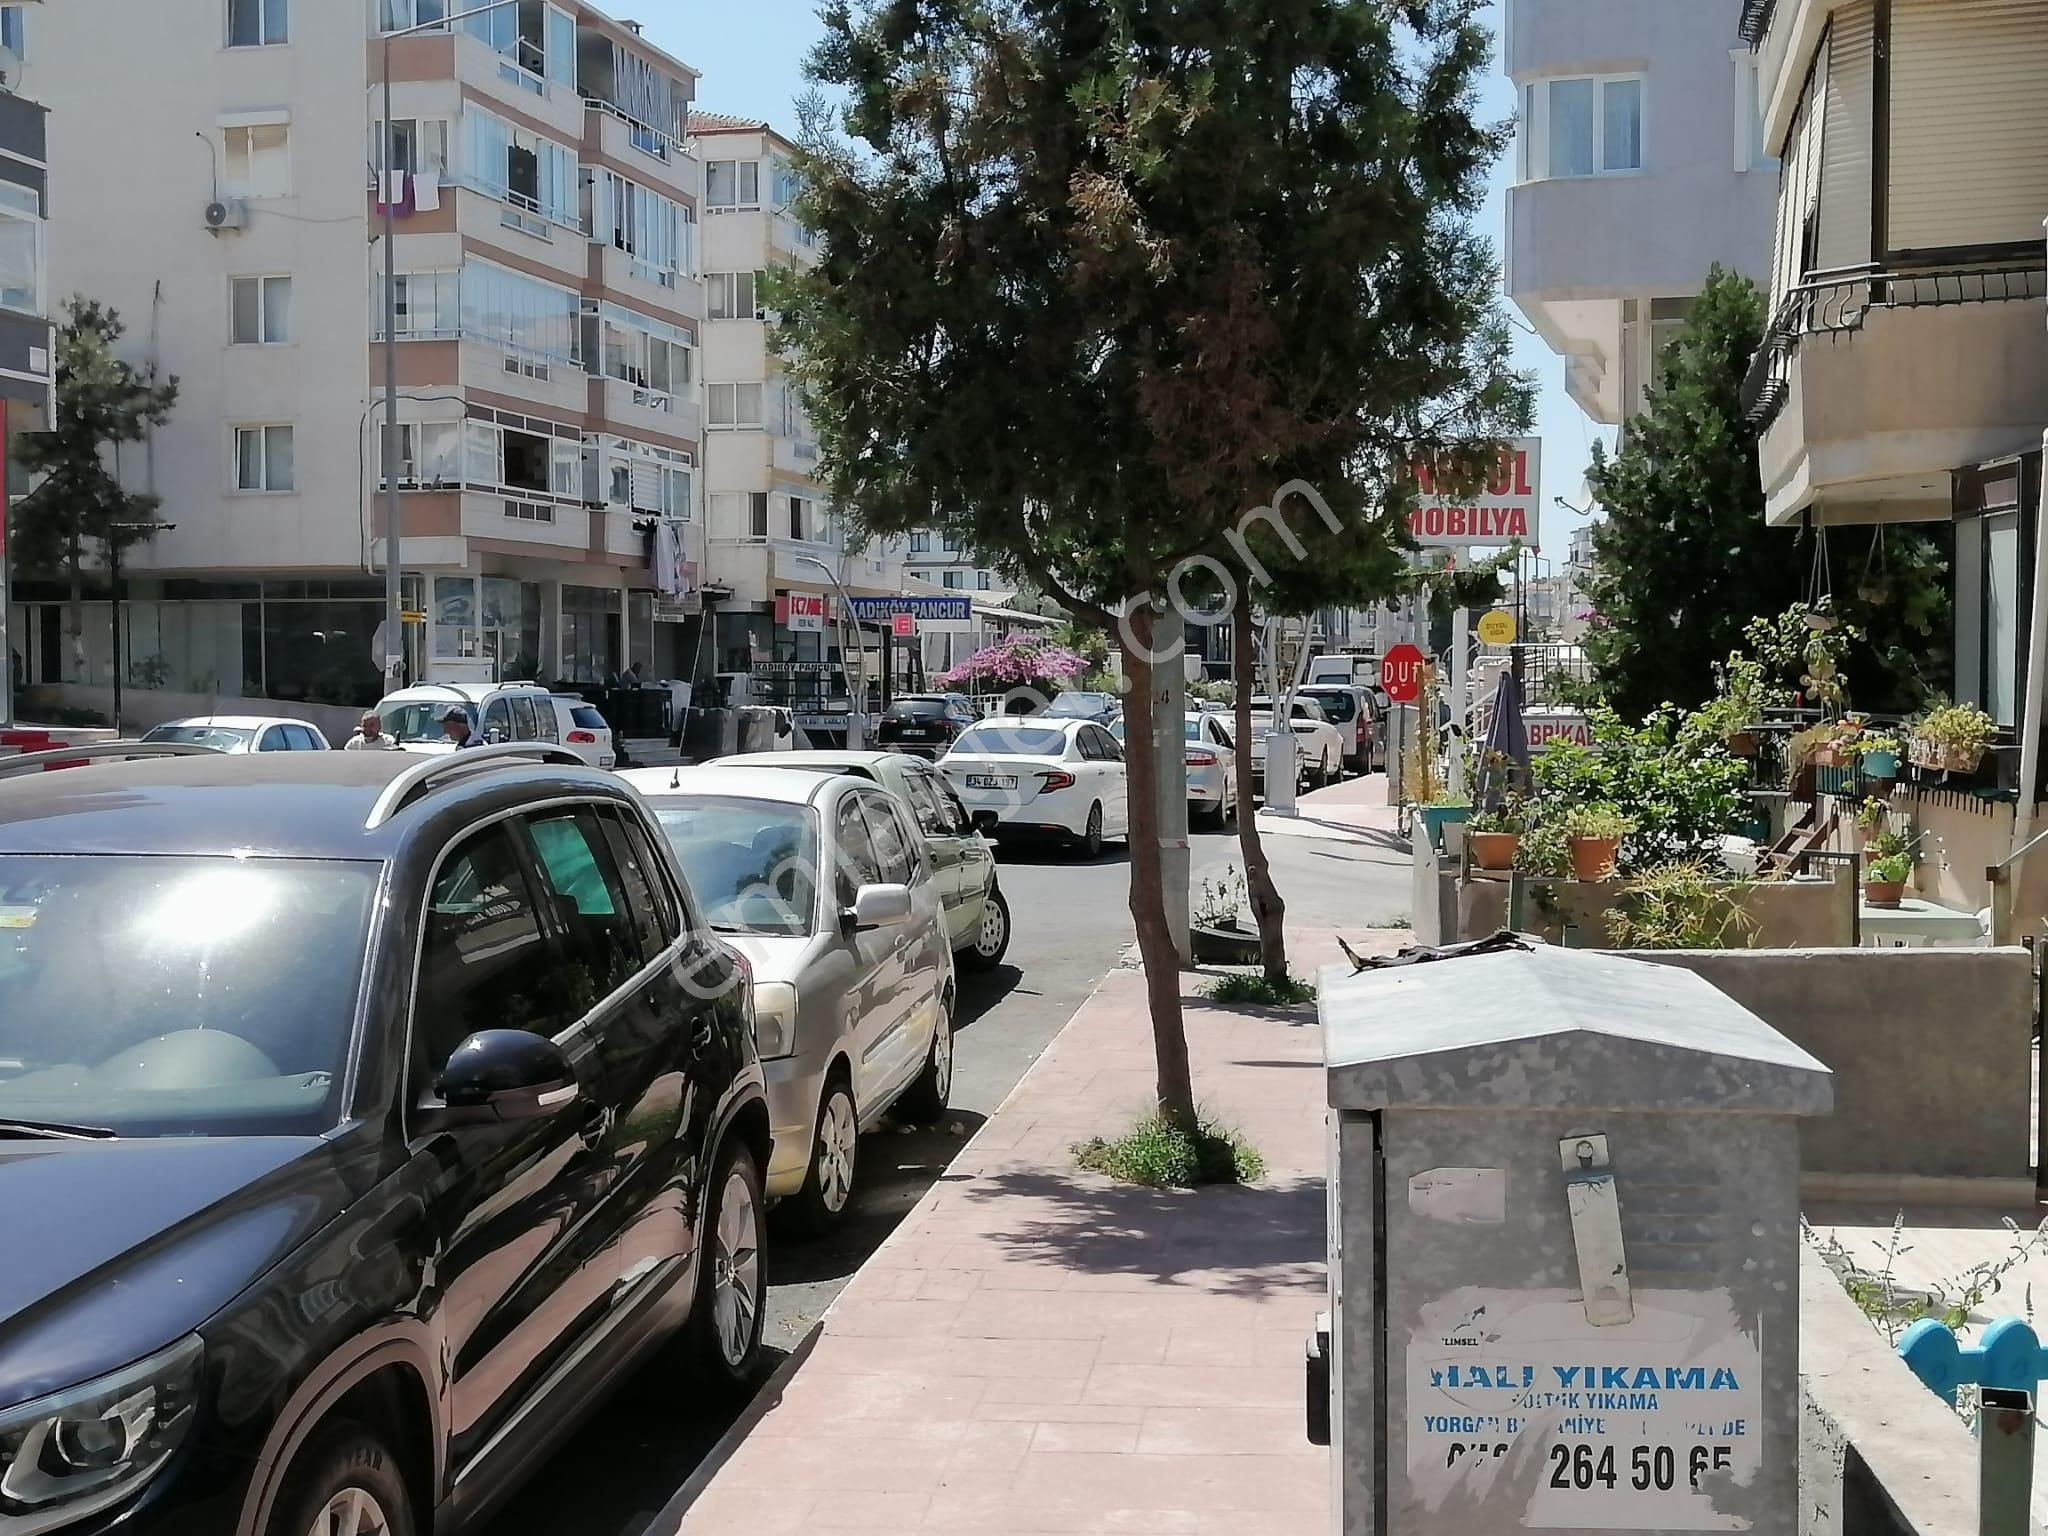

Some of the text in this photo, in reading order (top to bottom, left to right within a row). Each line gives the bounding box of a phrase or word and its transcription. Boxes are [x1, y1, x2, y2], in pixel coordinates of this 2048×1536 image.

[1552, 1366, 1740, 1391] YIKAMA
[1586, 1392, 1659, 1410] YIKAMA
[1550, 1443, 1618, 1491] 264
[1631, 1445, 1675, 1491] 50
